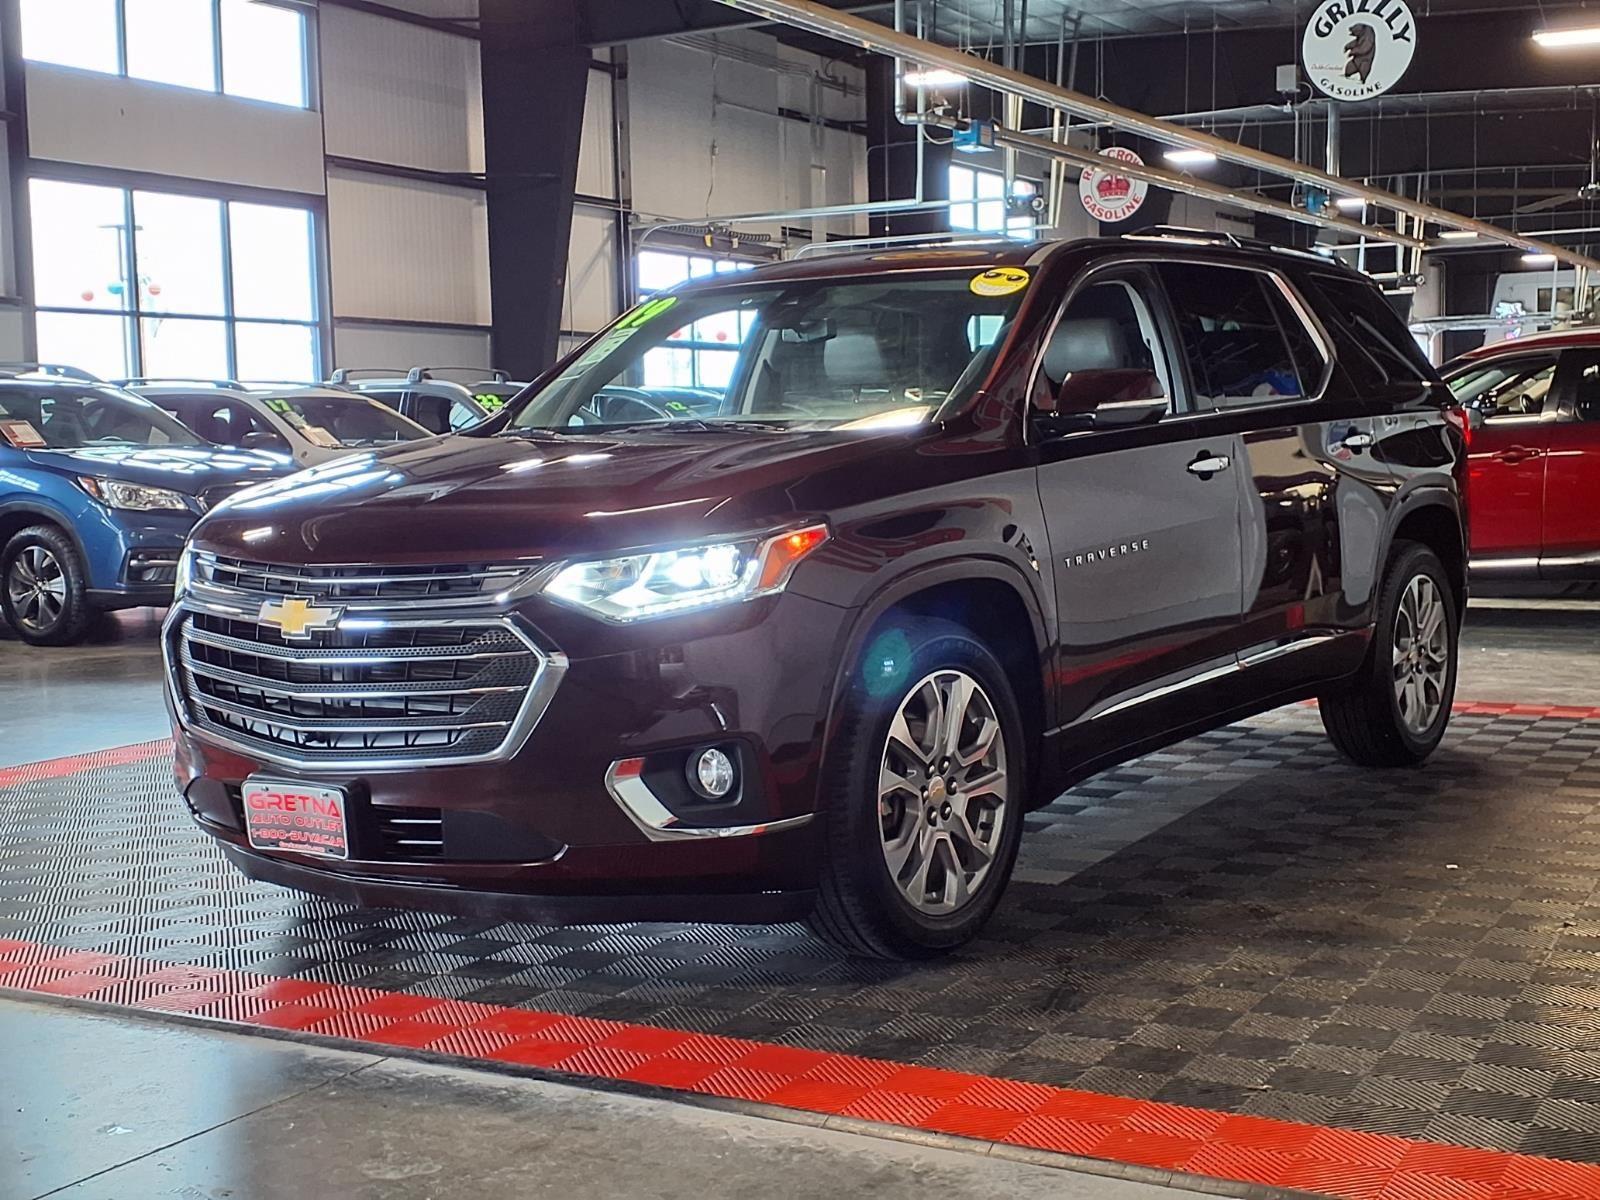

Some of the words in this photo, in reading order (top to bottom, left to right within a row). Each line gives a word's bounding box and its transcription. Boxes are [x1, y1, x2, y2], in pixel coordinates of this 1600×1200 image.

[1315, 0, 1411, 42] GRIZZLY
[1320, 78, 1382, 97] GASOLINE
[1083, 193, 1142, 220] GASOLINE
[1064, 539, 1149, 568] TRAVERSE
[248, 792, 341, 818] GRETNA
[250, 813, 291, 825] AUTO
[294, 815, 343, 832] OUTLET
